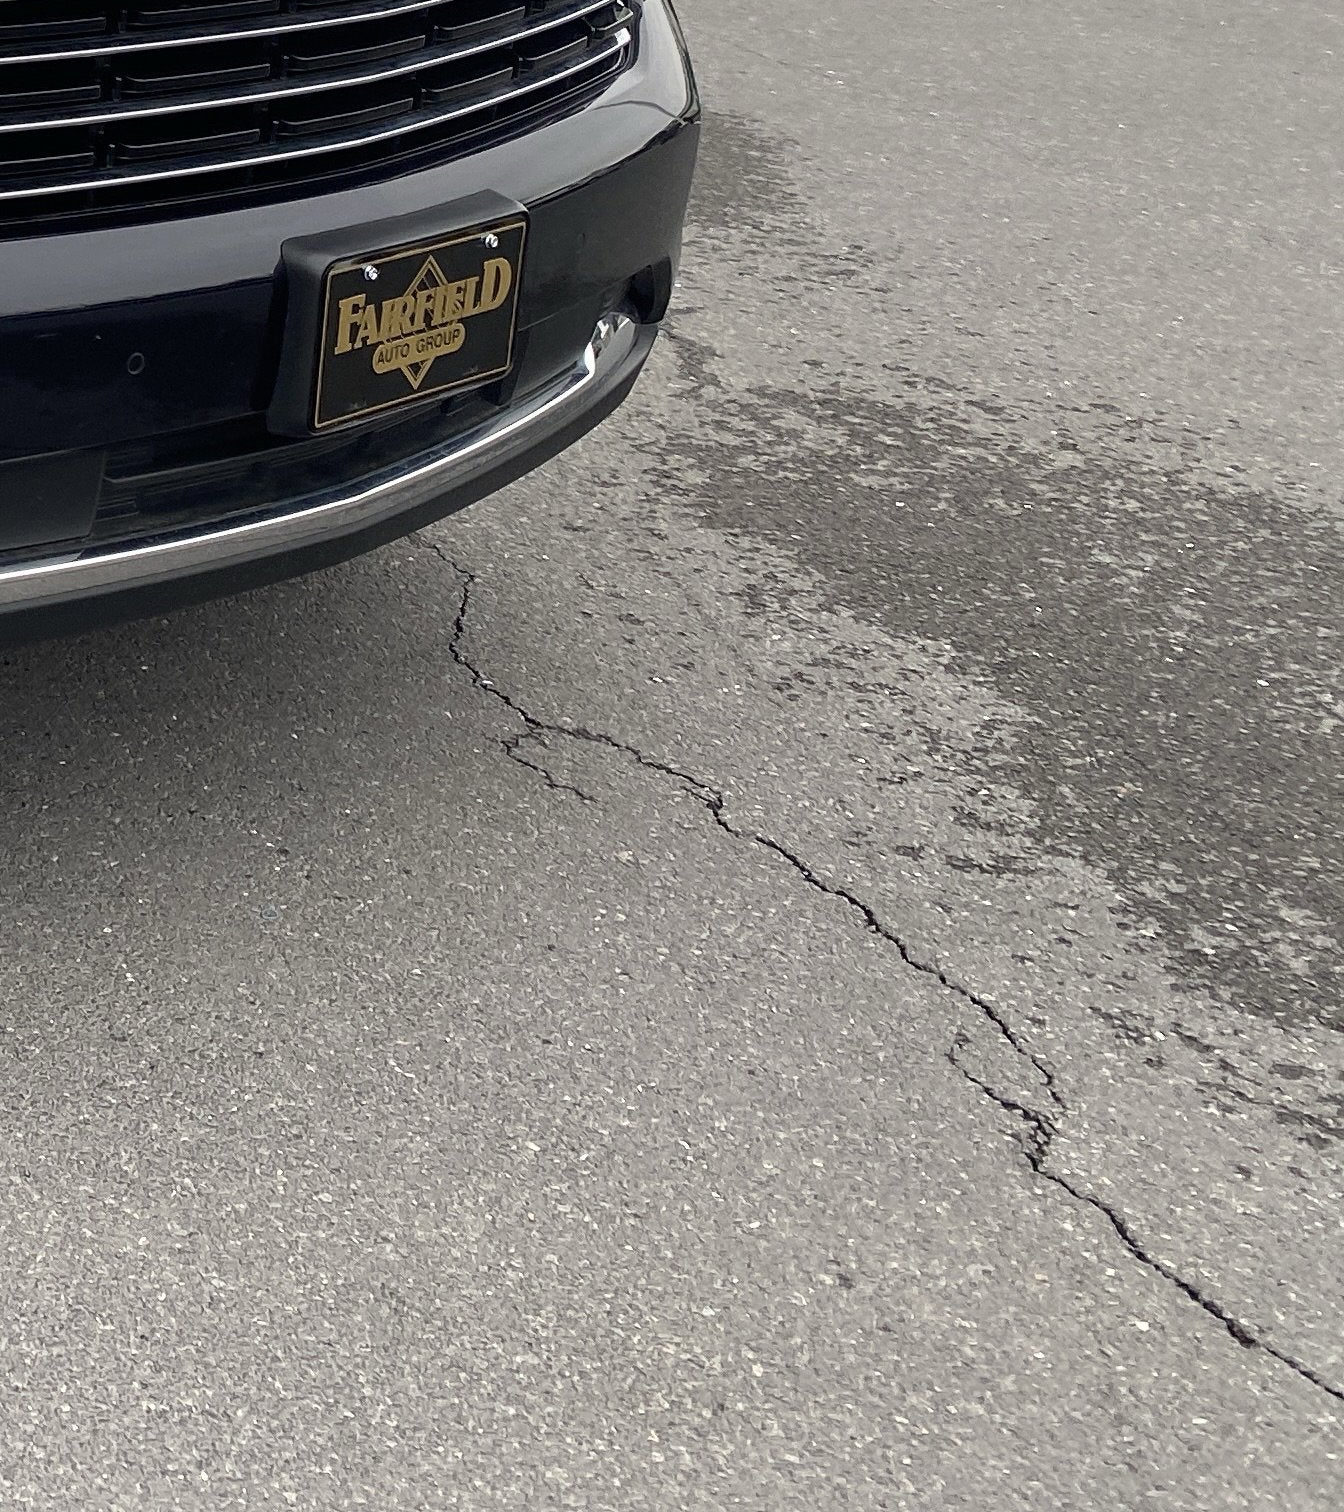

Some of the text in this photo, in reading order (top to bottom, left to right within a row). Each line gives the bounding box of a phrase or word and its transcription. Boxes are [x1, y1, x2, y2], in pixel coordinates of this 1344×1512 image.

[334, 257, 512, 355] FAIRFIELD
[377, 328, 461, 365] AUTO GROUP
